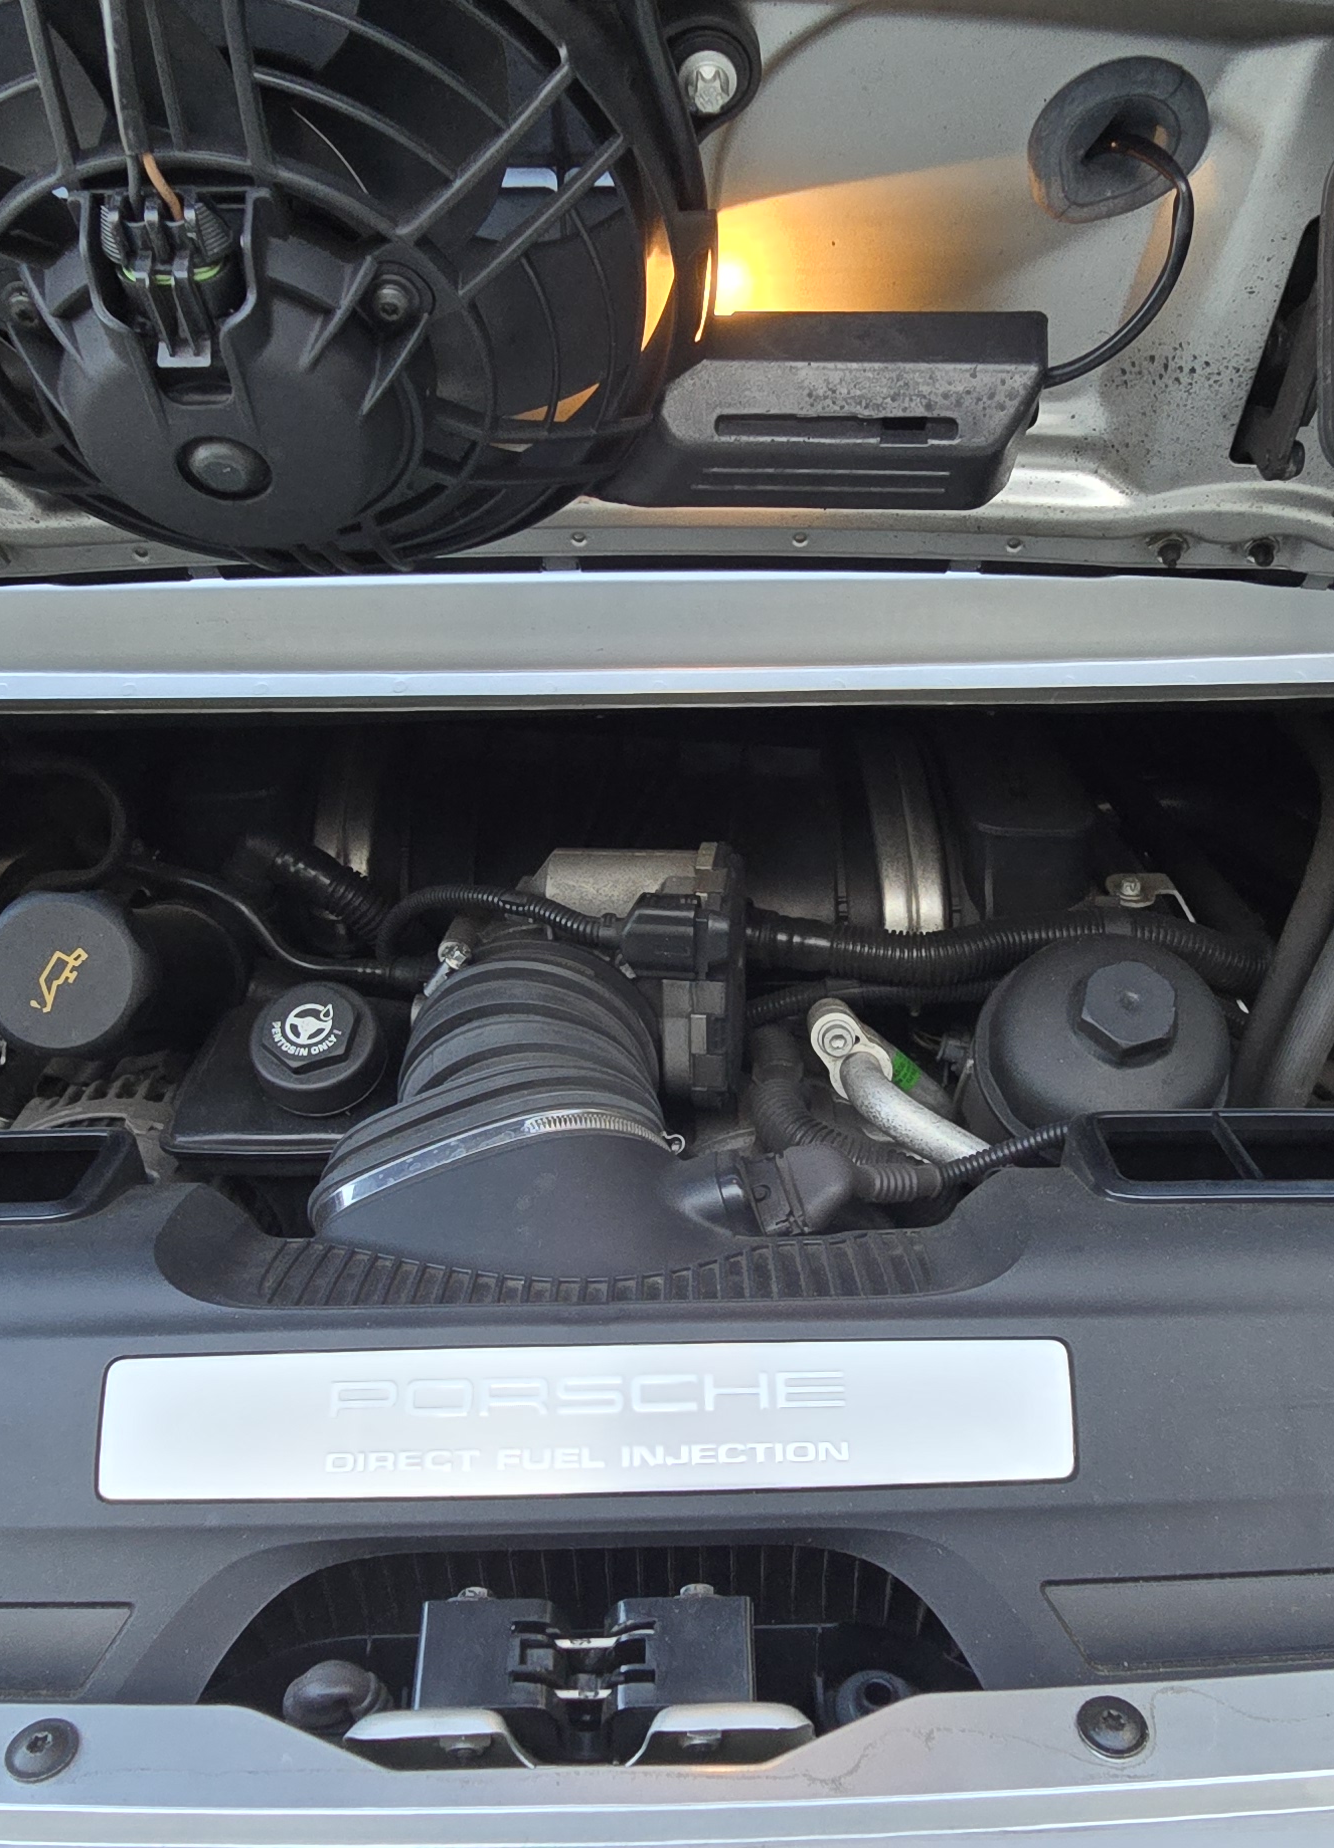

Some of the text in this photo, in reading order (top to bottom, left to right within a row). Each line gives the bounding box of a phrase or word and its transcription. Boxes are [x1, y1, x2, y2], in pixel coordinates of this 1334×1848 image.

[271, 1021, 308, 1056] PENTOSIN
[330, 1370, 845, 1418] PORSCHE
[325, 1441, 849, 1473] DIRECT FUEL INJECTION
